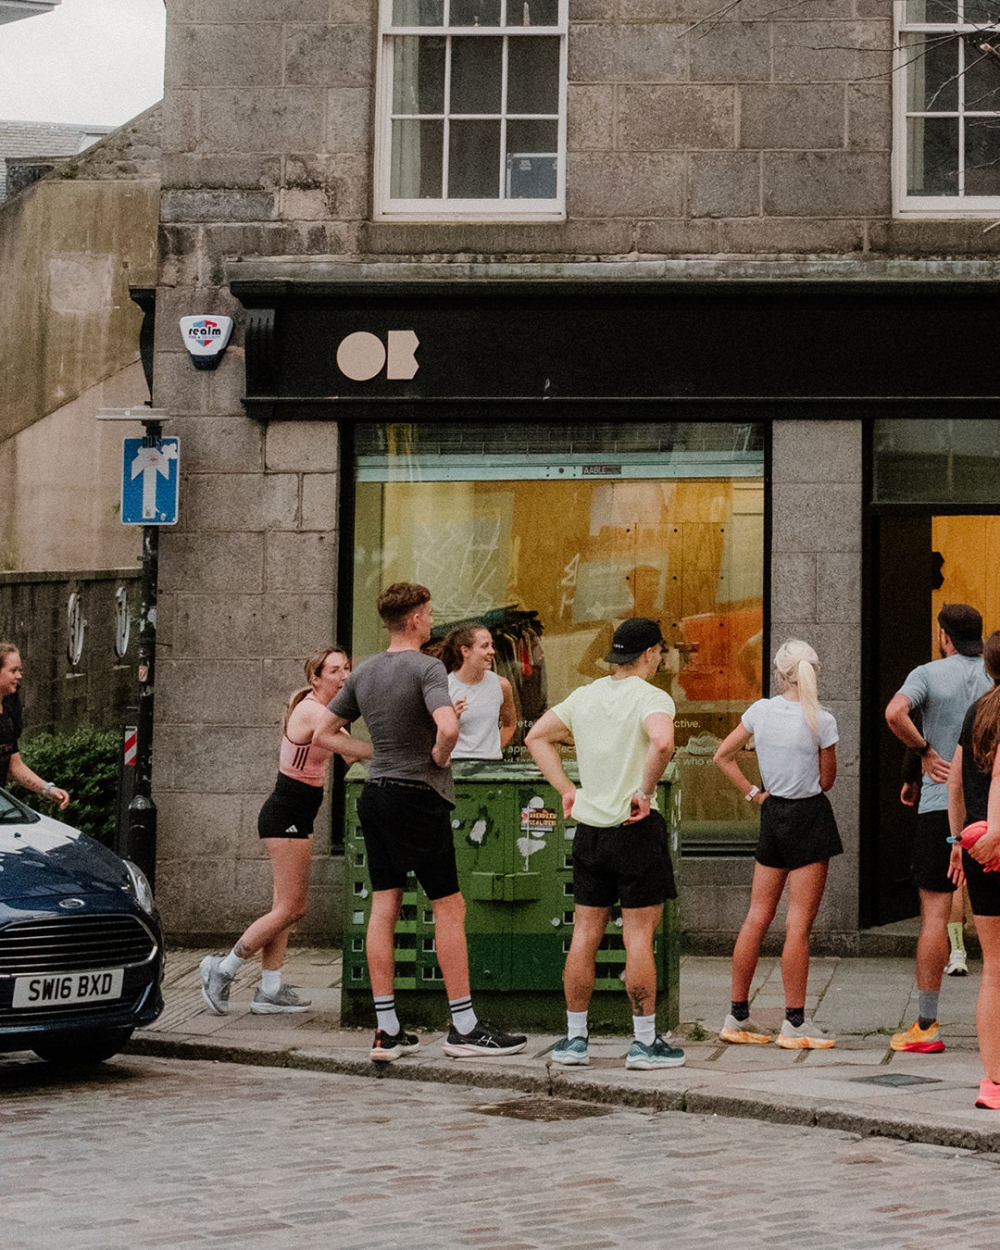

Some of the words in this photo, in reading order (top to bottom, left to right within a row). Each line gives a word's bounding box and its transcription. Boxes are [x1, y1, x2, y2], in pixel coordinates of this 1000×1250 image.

[188, 325, 222, 336] realm
[683, 758, 704, 766] who
[28, 977, 73, 1001] SW16
[77, 973, 112, 997] BXD
